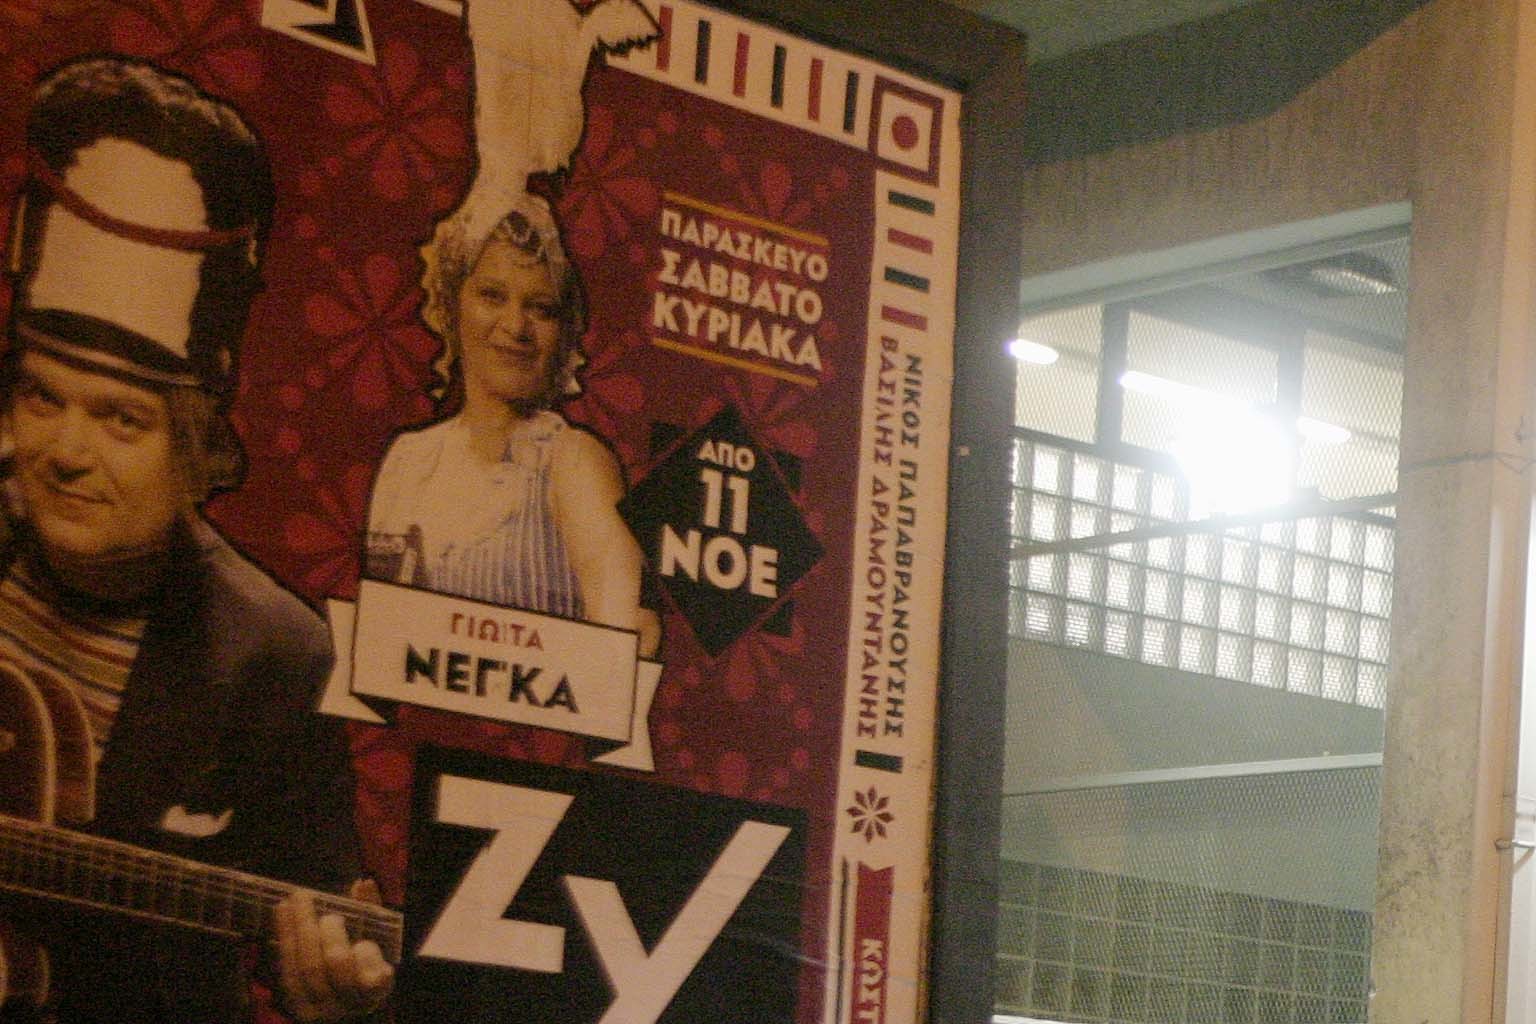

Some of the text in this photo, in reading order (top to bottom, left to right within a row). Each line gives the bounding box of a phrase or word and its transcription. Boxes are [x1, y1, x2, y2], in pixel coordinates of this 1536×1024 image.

[657, 248, 823, 325] ΣΑΒΒΑΤΟ
[653, 291, 823, 371] ΚΥΡΙΑΚΑ
[874, 335, 899, 466] ΒΑΣΙΛΗΣ
[901, 354, 922, 448] ΝΙΚΟΣ
[697, 439, 756, 472] ΑΠΟ
[702, 467, 750, 535] 11
[660, 523, 778, 598] ΝΟΕ
[450, 612, 545, 651] ΓΙΩΤΑ
[405, 642, 579, 713] ΝΕΓΚΑ
